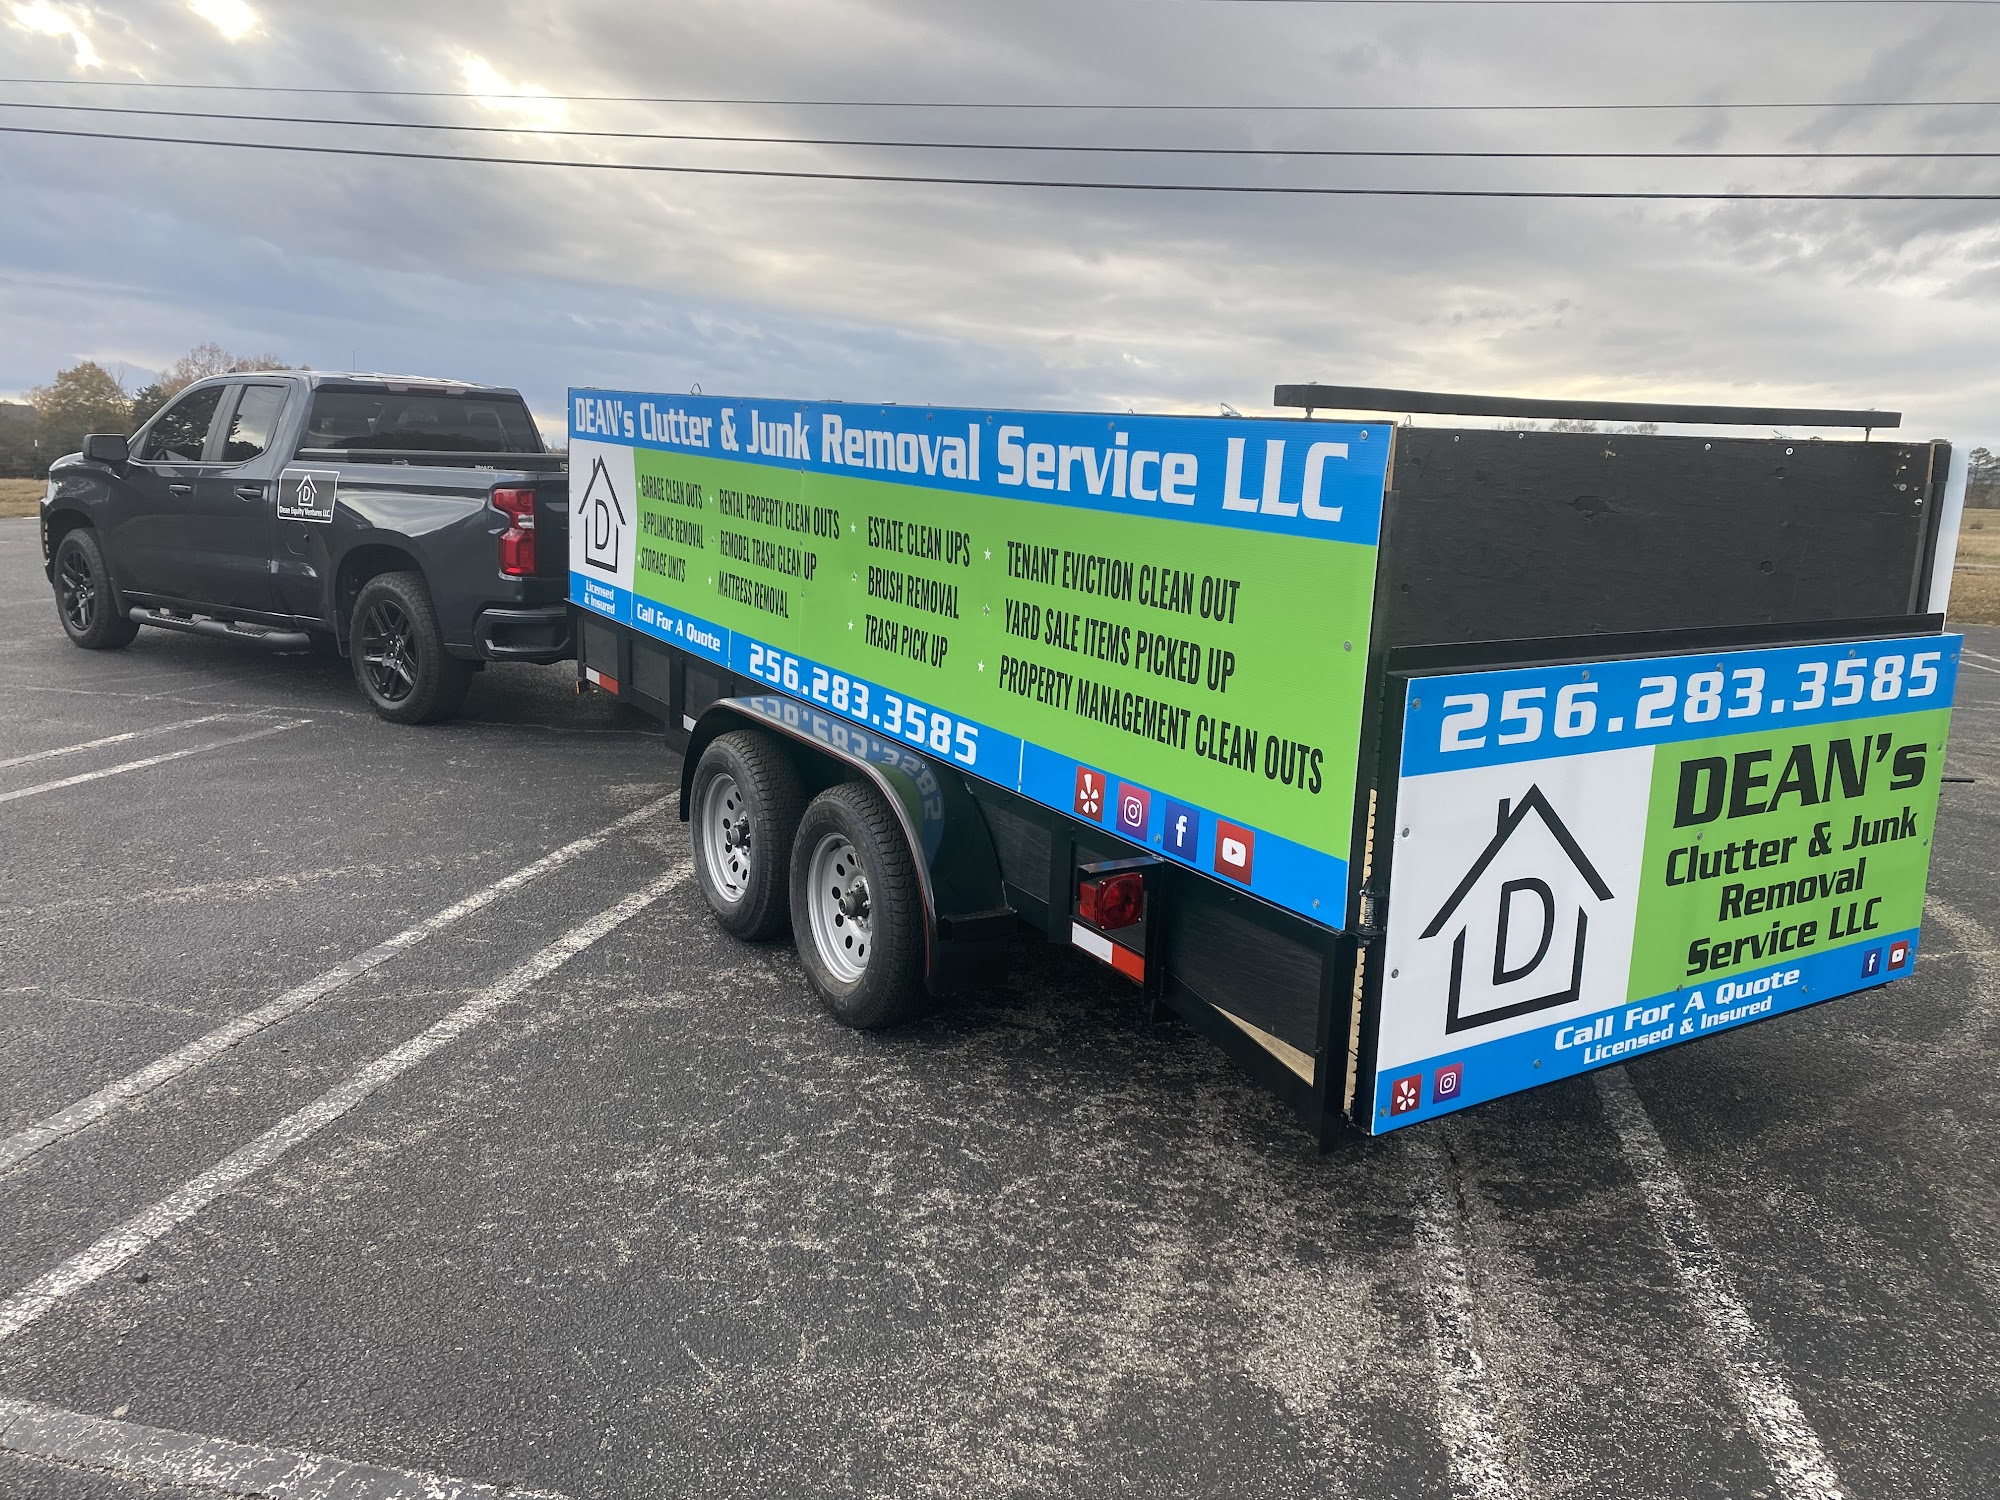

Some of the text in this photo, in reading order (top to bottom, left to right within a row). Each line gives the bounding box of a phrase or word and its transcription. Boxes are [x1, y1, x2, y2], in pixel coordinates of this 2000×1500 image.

[575, 398, 1349, 522] DEAN's Clutter & Junk Removal Service LLC
[641, 474, 703, 509] GARAGE CLEAN OUTS
[719, 488, 840, 540] RENTAL PROPERTY CLEAN OUTS
[595, 498, 610, 550] D
[643, 511, 704, 549] APPLIANCE REMOVAL
[868, 515, 970, 567] ESTATE CLEAN UPS
[640, 547, 686, 582] STORAGE UNITS
[720, 530, 817, 581] REMODEL TRASH CLEAN UP
[1007, 541, 1241, 624] TENANT EVICTION CLEAN OUT
[584, 592, 615, 615] & Insured
[585, 580, 614, 601] Licensed
[718, 570, 789, 619] MATTRESS REMOVAL
[868, 565, 959, 619] BRUSH REMOVAL
[636, 603, 721, 652] Call For A Quote
[865, 613, 948, 668] TRASH PICK UP
[1005, 597, 1236, 693] YARD SALE ITEMS PICKED UP
[749, 642, 979, 766] 256.283.3585
[999, 654, 1324, 795] PROPERTY MANAGEMENT CLEAN OUTS
[1438, 651, 1942, 753] 256.283.3585
[1672, 732, 1928, 829] DEAN's
[1665, 806, 1918, 887] Clutter & Junk
[1718, 857, 1865, 922] Removal
[1492, 876, 1555, 986] D
[1687, 897, 1882, 976] Service LLC
[1554, 968, 1801, 1051] Call For A Quote
[1583, 996, 1772, 1065] Licensed & Insured
